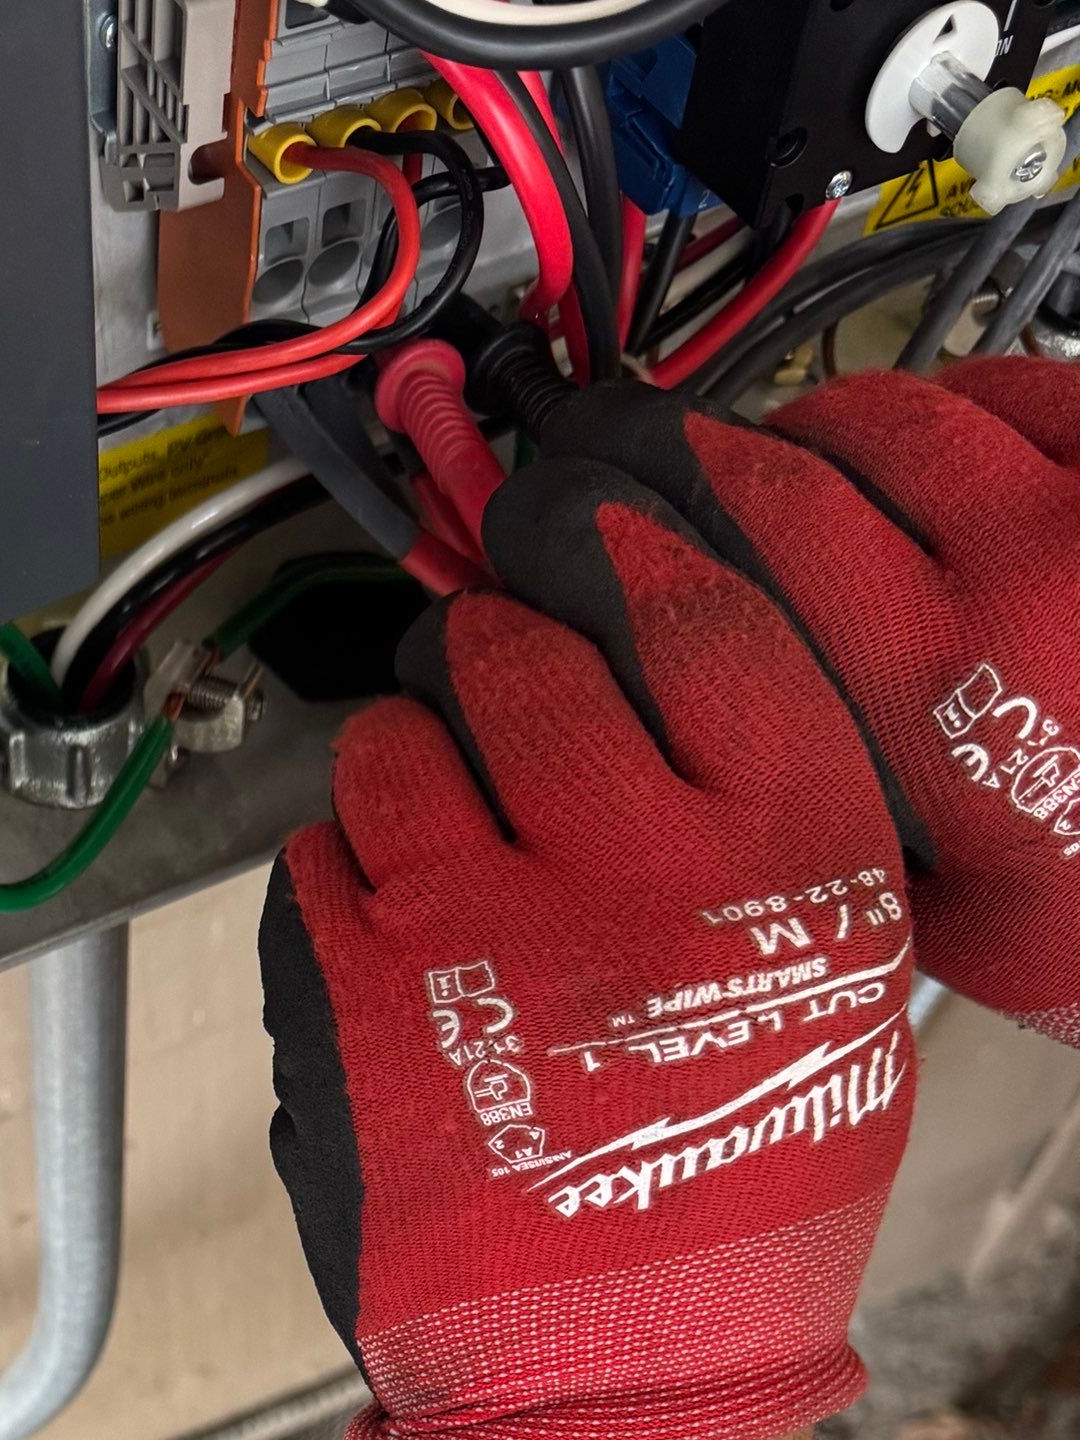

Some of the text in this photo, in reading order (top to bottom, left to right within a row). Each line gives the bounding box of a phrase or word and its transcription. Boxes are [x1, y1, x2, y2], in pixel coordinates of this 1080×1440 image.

[702, 867, 886, 925] 48-22-8901
[750, 917, 811, 955] M
[584, 982, 885, 1072] CUT LEVEL 1
[480, 1102, 533, 1126] EN388
[548, 1030, 906, 1218] Milwaukee
